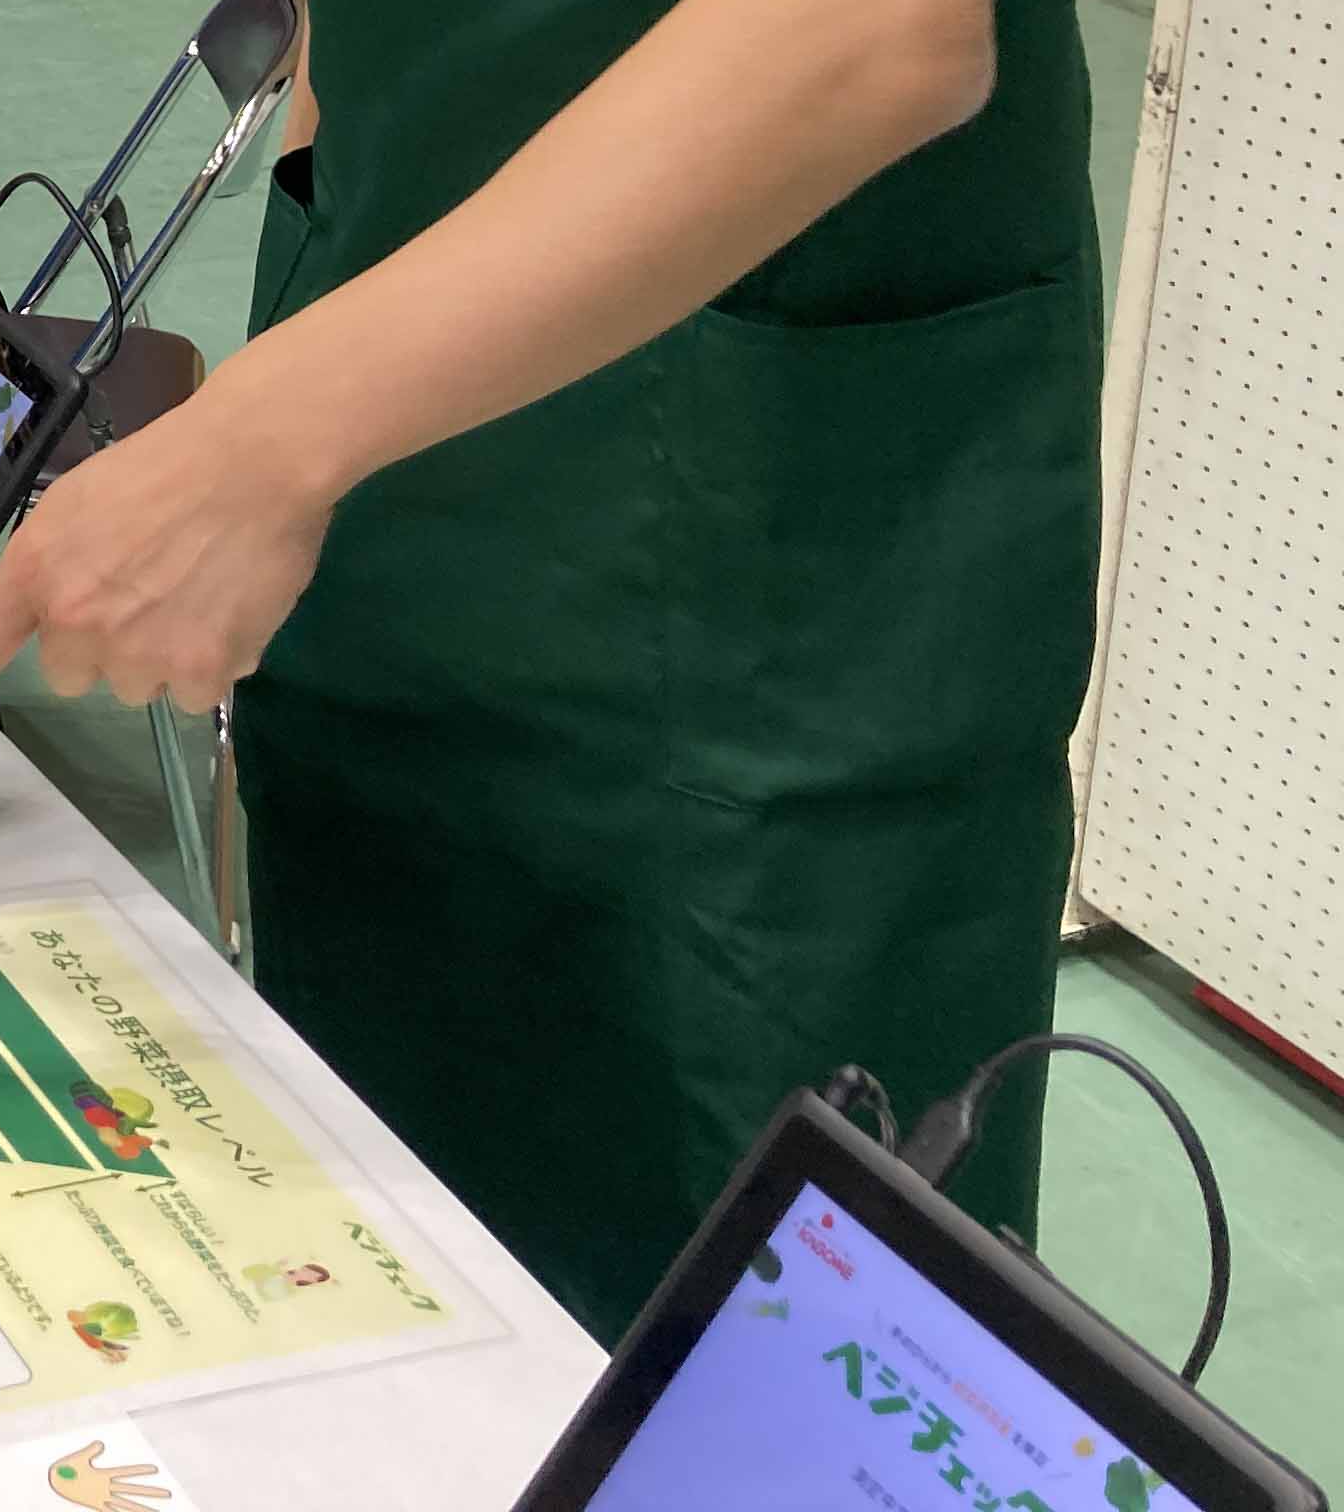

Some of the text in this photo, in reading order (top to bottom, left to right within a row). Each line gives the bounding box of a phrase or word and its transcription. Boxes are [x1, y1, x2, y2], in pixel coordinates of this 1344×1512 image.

[28, 926, 274, 1190] あなたの野菜摂取レベル
[341, 1220, 444, 1314] ベジチェック
